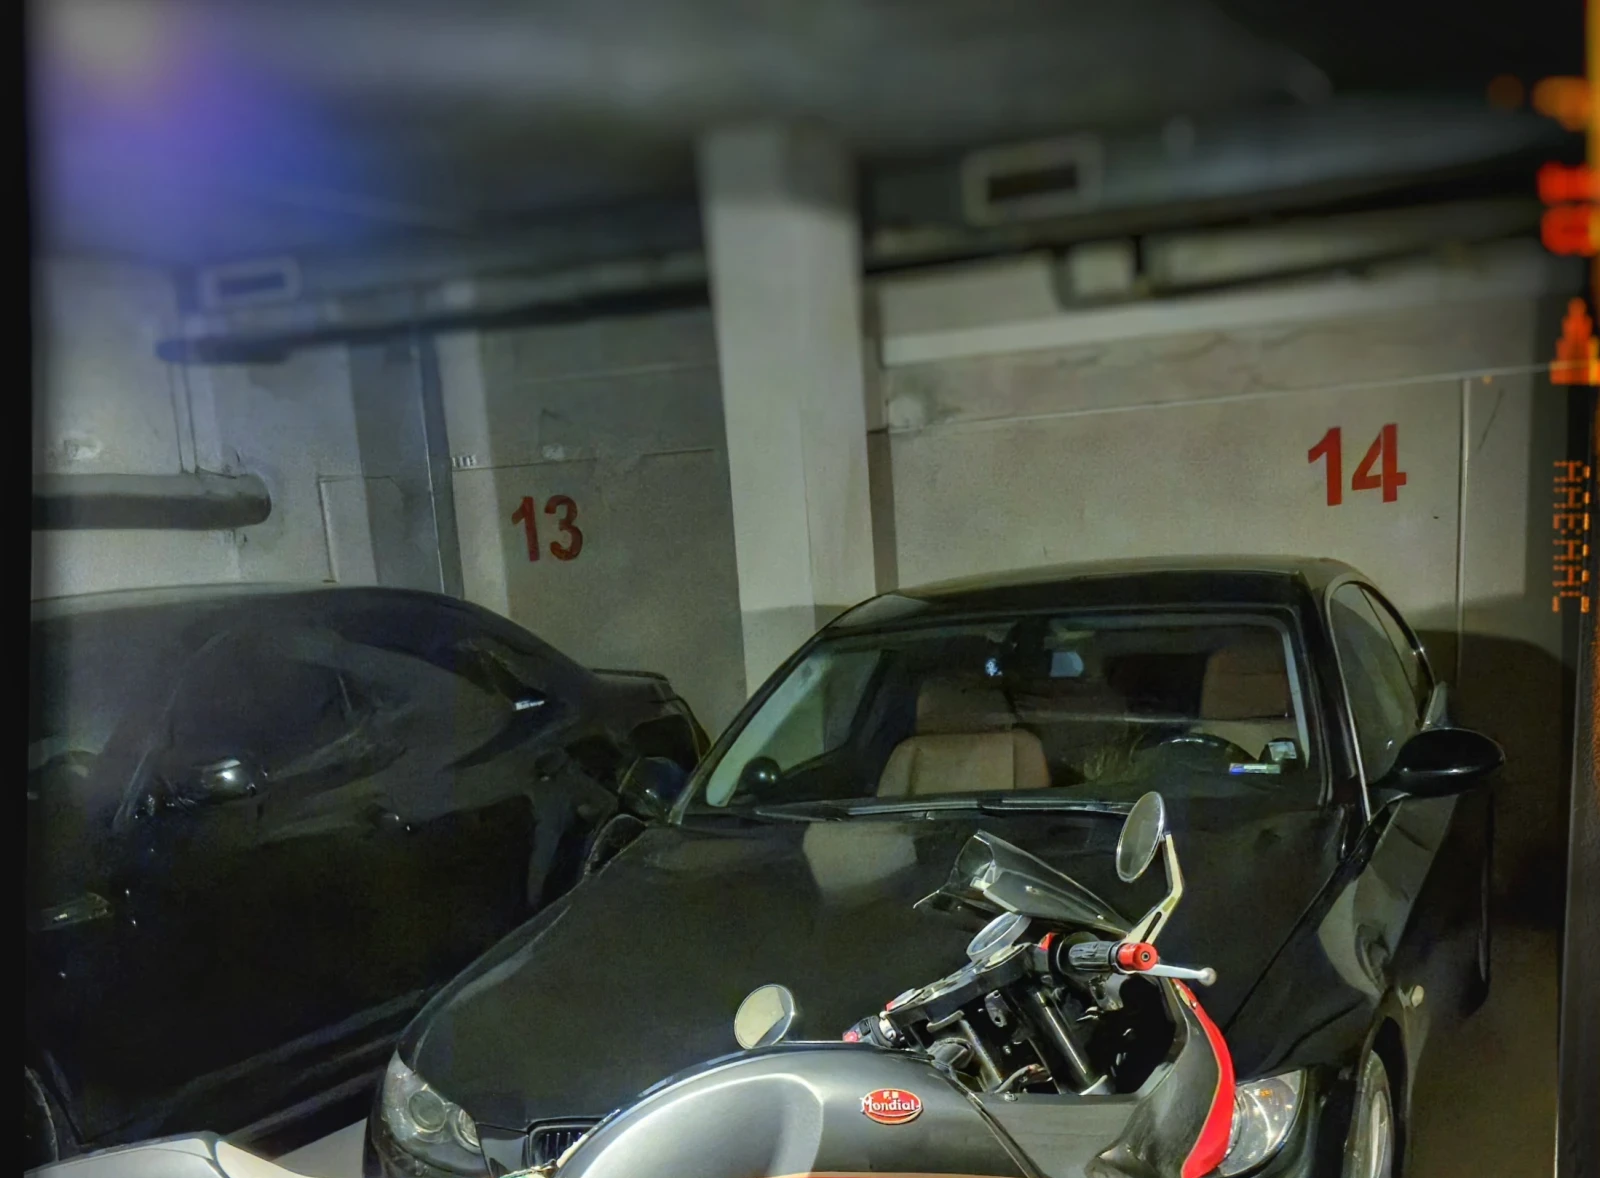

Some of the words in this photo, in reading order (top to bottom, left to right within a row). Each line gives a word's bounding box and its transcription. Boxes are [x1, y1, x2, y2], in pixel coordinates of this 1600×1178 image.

[1308, 423, 1407, 506] 14
[512, 495, 583, 562] 13
[859, 1096, 915, 1113] Mondial
